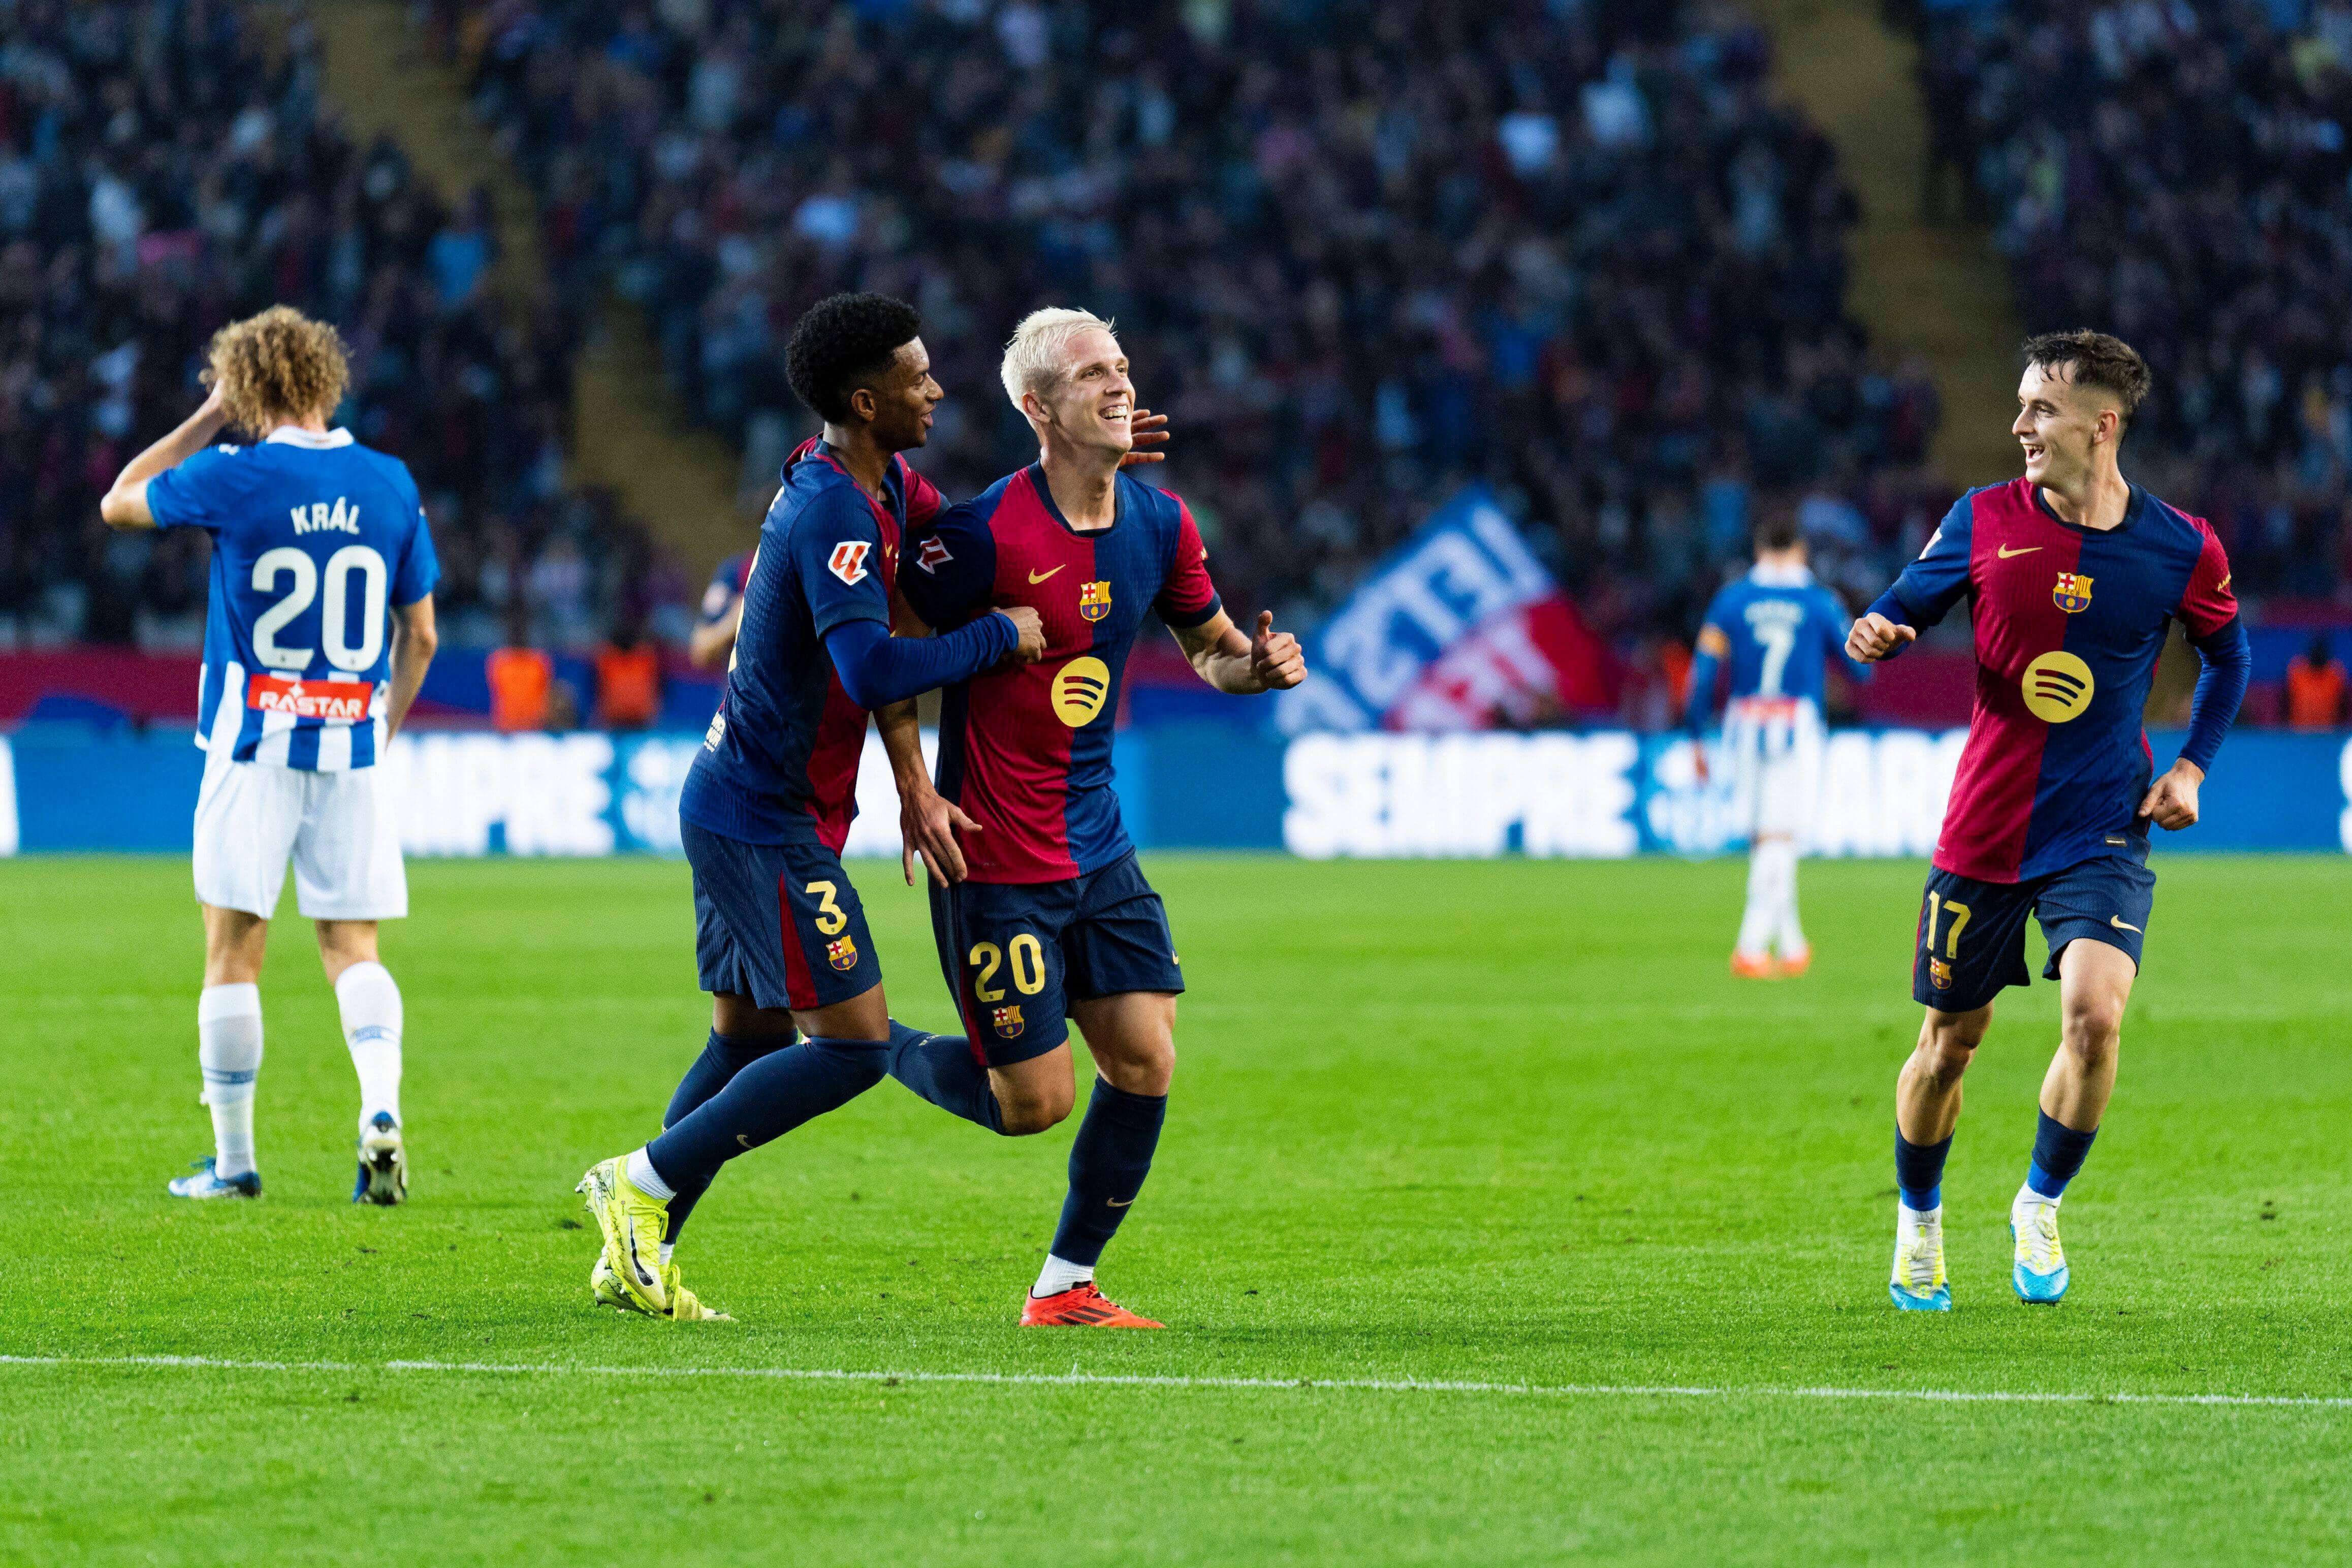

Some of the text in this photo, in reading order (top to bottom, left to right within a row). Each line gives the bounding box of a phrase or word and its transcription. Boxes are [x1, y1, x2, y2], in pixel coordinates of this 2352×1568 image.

[291, 496, 360, 535] KRÁL
[252, 545, 387, 671] 20
[1753, 623, 1797, 697] 7
[259, 691, 363, 718] RASTAR
[1285, 734, 1637, 857] SEMPRE
[806, 881, 847, 935] 3
[1927, 890, 1972, 959] 17
[969, 934, 1045, 1002] 20
